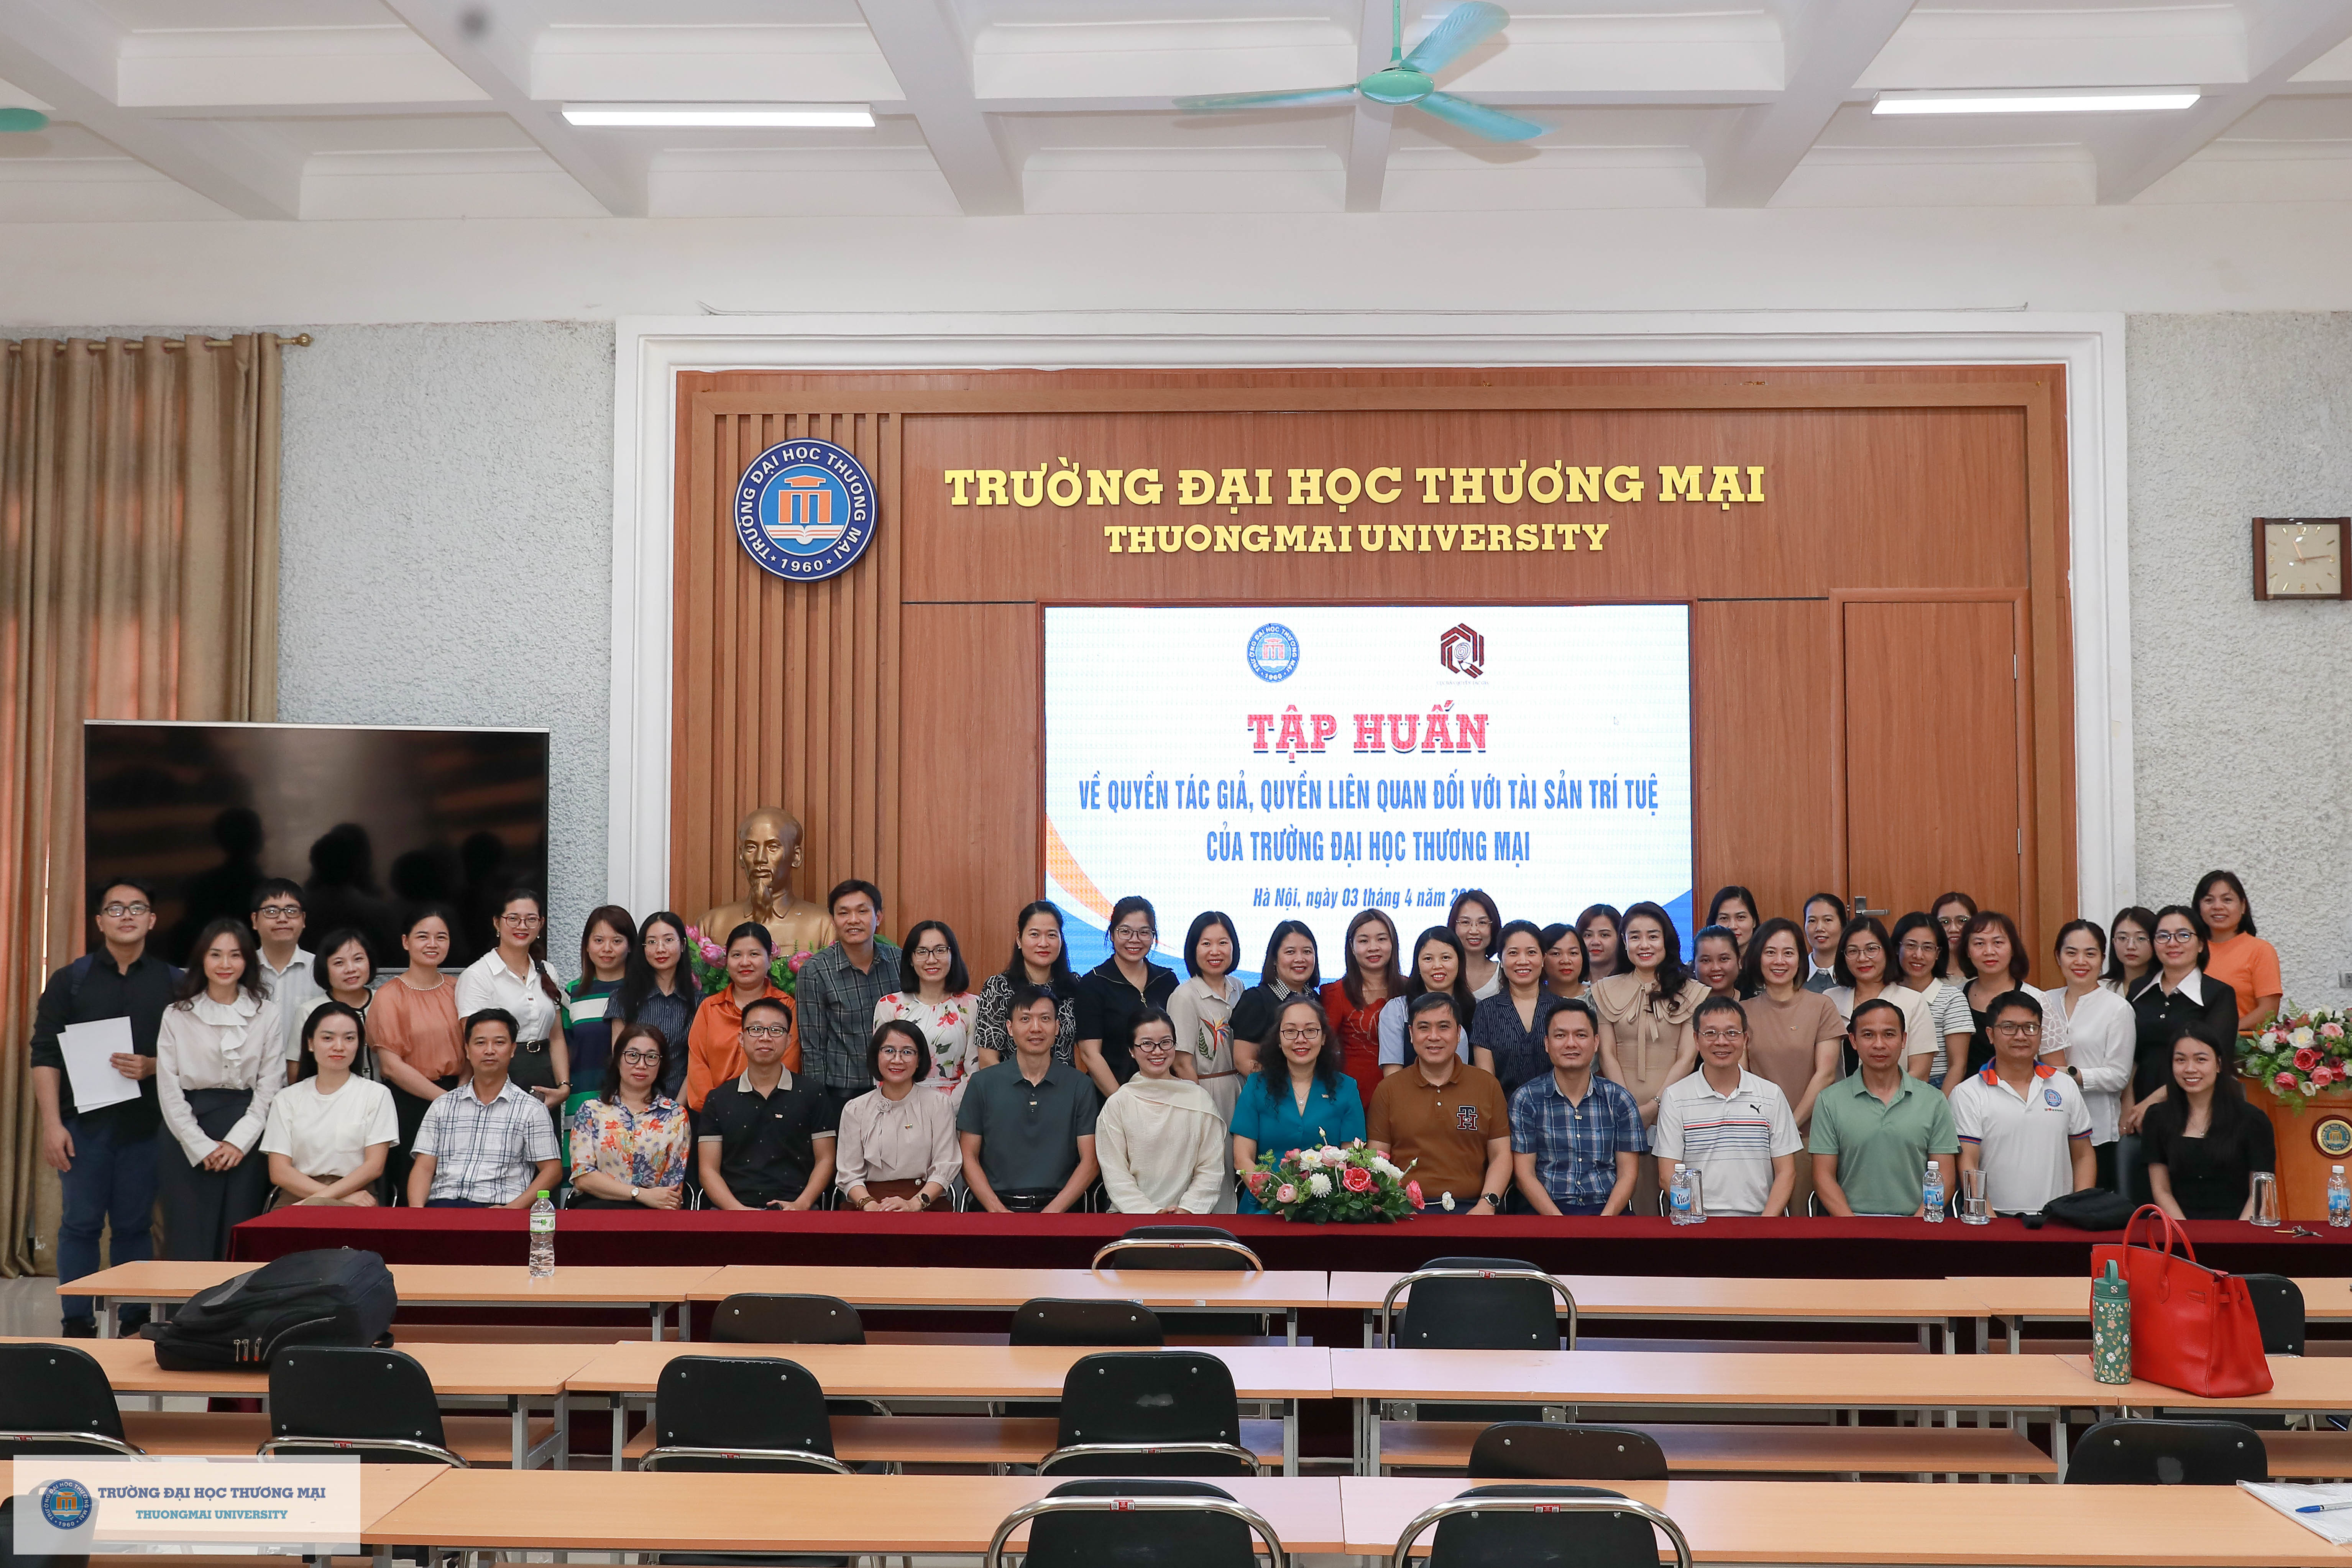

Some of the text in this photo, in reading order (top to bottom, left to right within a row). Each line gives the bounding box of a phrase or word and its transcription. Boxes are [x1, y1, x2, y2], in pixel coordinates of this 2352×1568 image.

[739, 447, 866, 559] TRƯỜNG ĐẠI HỌC THƯƠNG MẠI
[944, 456, 1764, 514] TRƯỜNG ĐẠI HỌC THƯƠNG MẠI
[1104, 524, 1609, 553] THUONGMAI UNIVERSITY
[781, 558, 823, 572] 1960
[1247, 700, 1489, 763] TẬP HUẤN
[1079, 769, 1658, 816] VỀ QUYỀN TÁC GIẢ, QUYỀN LIÊN QUAN ĐỐI VỚI TÀI SẢN TRÍ TUỆ
[1207, 821, 1529, 867] CỦA TRƯỜNG ĐẠI HỌC THƯƠNG MẠI
[1253, 888, 1270, 906] Hà
[1275, 887, 1301, 910] Nội,
[1306, 888, 1338, 909] ngày
[1342, 888, 1358, 906] 03
[1363, 887, 1400, 909] tháng
[1405, 888, 1412, 906] 4
[1417, 888, 1445, 907] năm
[1676, 1194, 1690, 1204] Vital
